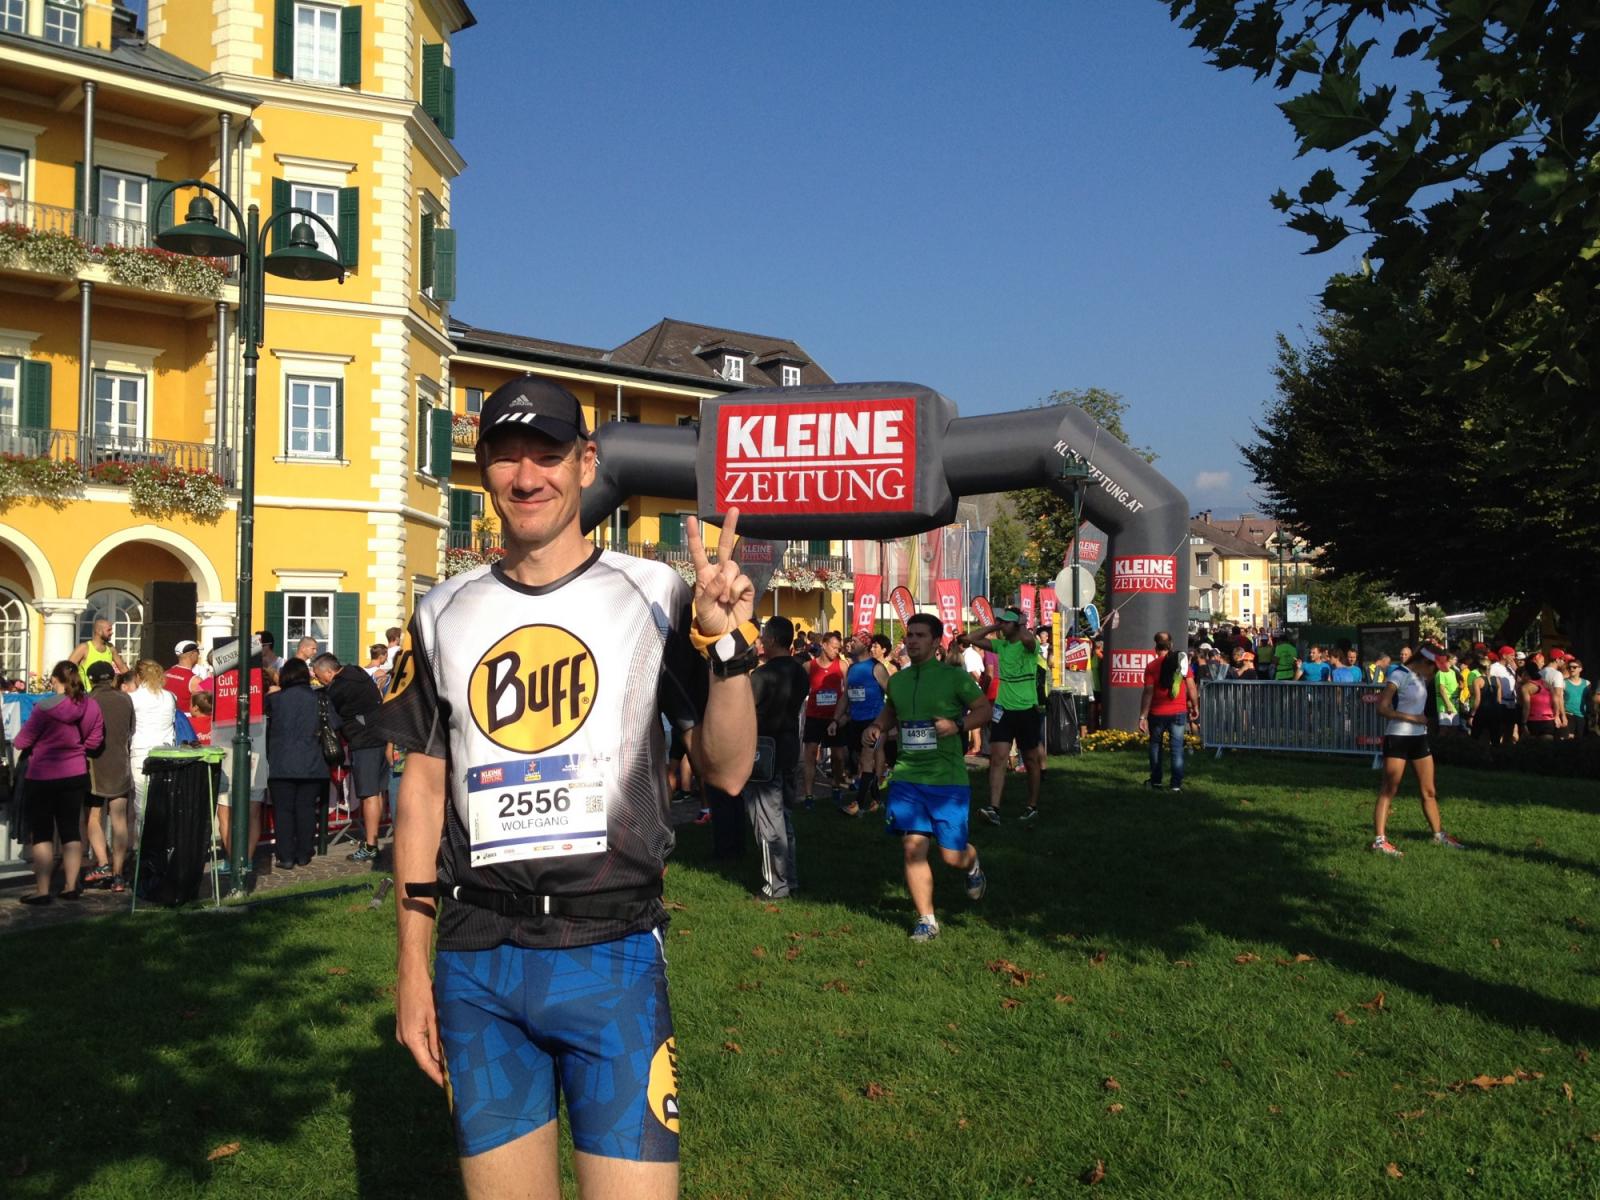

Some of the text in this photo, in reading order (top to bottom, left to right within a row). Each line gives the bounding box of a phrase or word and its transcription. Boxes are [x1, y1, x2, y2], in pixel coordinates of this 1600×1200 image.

[726, 410, 904, 458] KLEINE
[724, 468, 906, 502] ZEITUNG
[741, 544, 772, 553] KLEINE
[1115, 559, 1173, 575] KLEINE
[1113, 578, 1174, 590] ZEITUNG
[1112, 654, 1159, 668] KLEIN
[218, 675, 233, 686] Gut
[218, 689, 229, 697] zu
[498, 787, 571, 818] 2556
[501, 816, 569, 831] WOLFGANG
